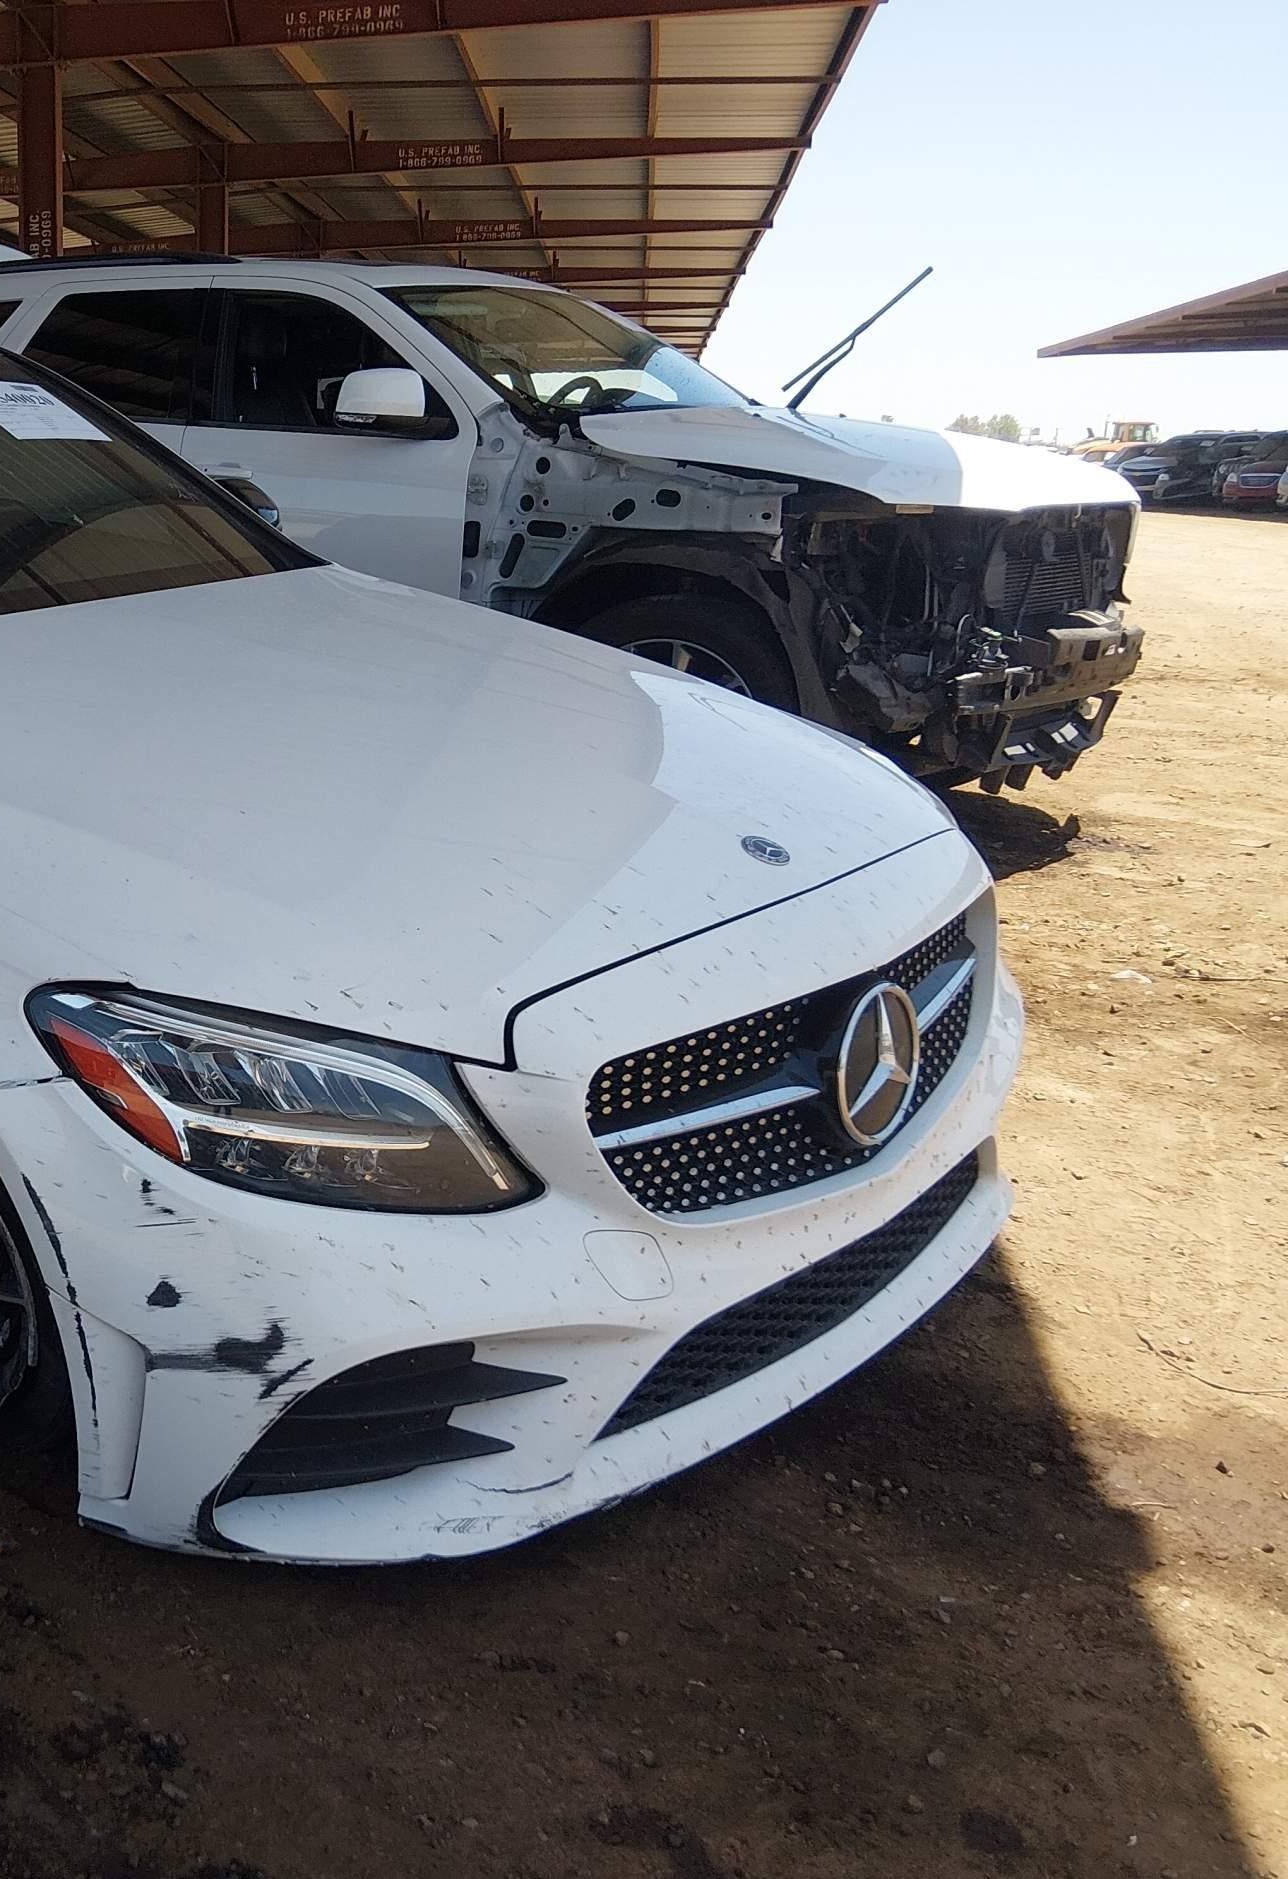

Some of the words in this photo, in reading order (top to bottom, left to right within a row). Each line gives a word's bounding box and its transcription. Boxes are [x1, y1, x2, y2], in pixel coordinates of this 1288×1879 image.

[285, 11, 311, 25] U.S.
[318, 6, 372, 23] PREFAB
[398, 148, 417, 158] U.S.
[422, 145, 460, 156] PREFAB
